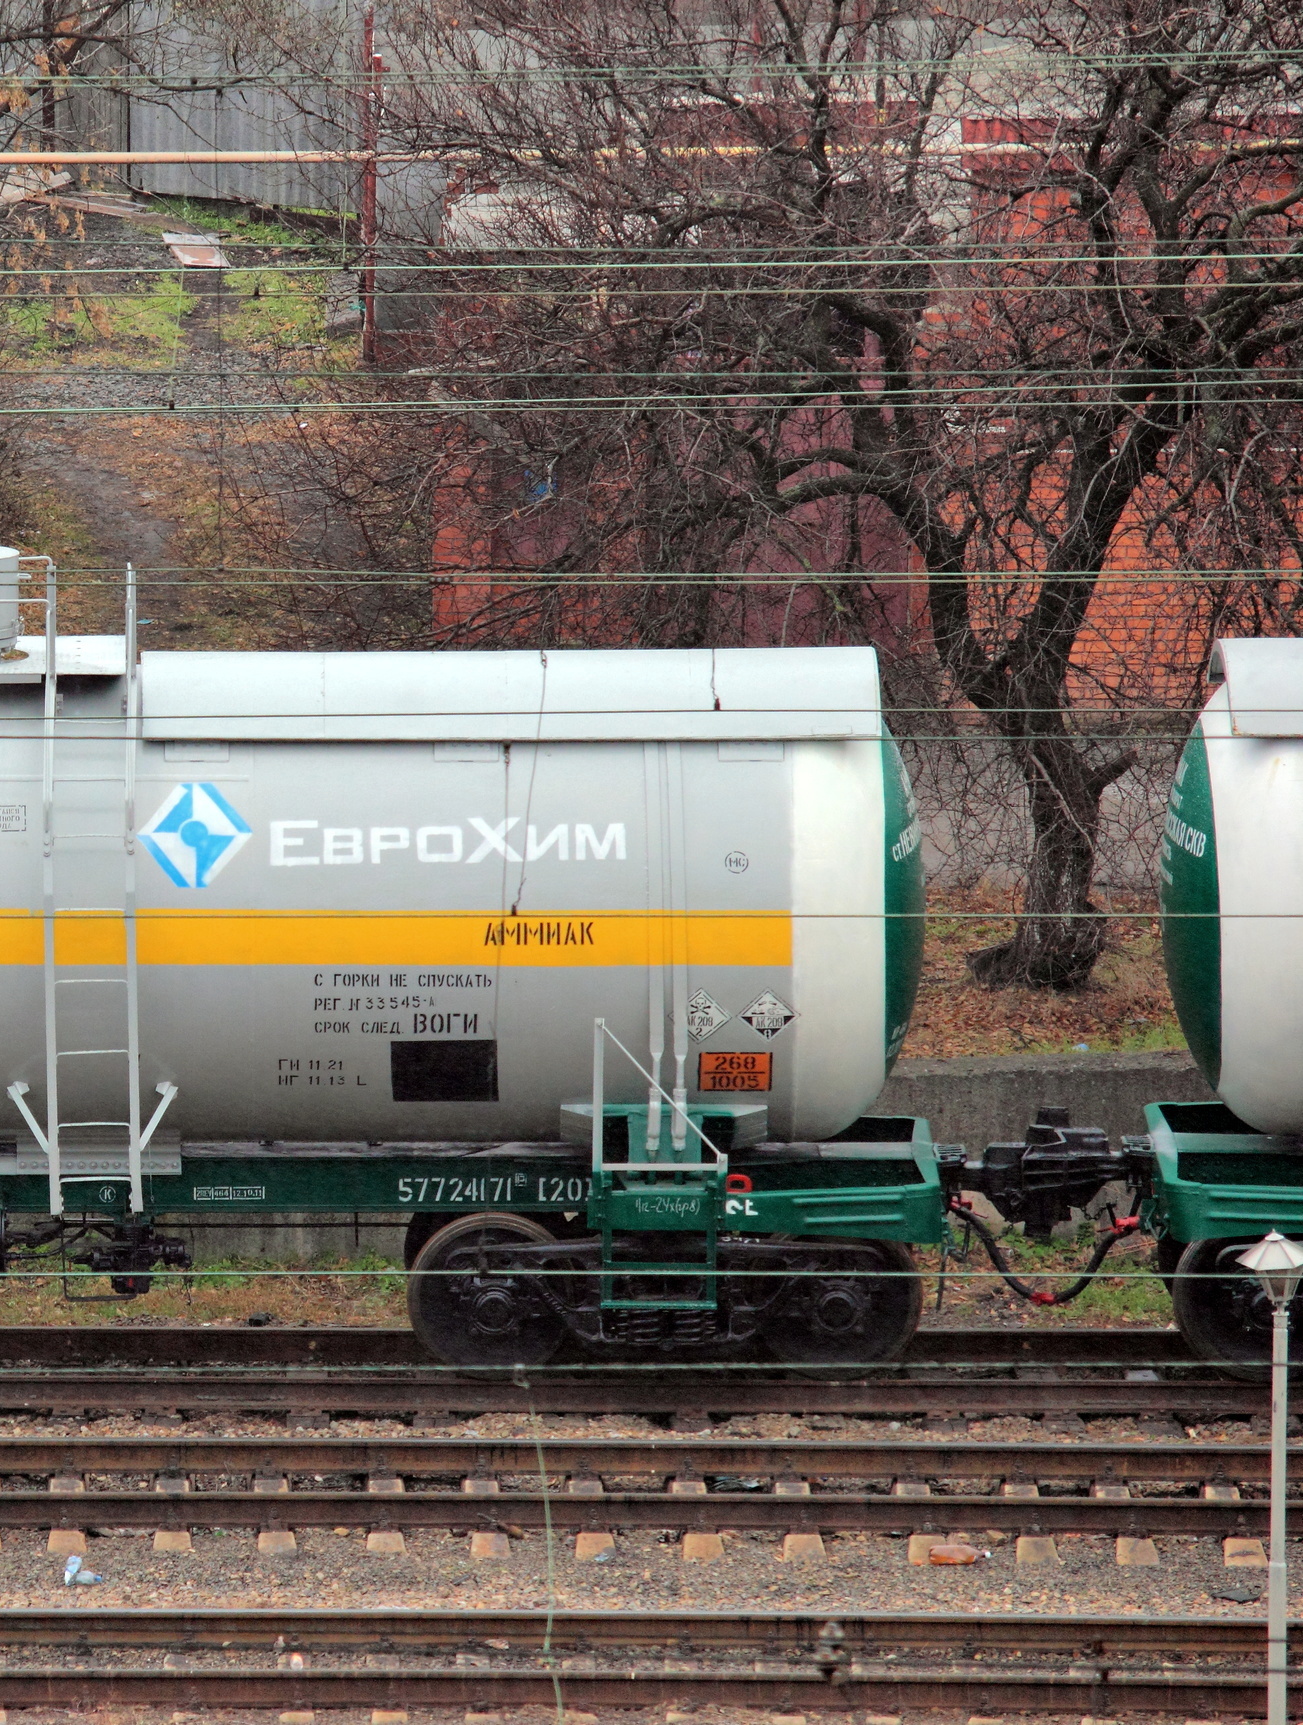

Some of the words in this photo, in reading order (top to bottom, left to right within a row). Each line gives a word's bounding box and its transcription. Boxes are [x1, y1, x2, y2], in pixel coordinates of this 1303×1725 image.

[484, 922, 595, 946] АММИАК
[314, 974, 323, 987] С
[333, 974, 380, 988] ГОРКИ
[390, 974, 407, 988] НЕ
[418, 974, 492, 988] СПУСКАТЬ
[314, 1021, 351, 1034] СРОК
[361, 1021, 405, 1035] СЛЕД.
[413, 1013, 478, 1034] ВОГИ
[696, 1028, 703, 1037] 2
[714, 1056, 756, 1070] 268
[710, 1075, 759, 1089] 1005
[104, 1189, 112, 1200] К
[398, 1177, 511, 1203] 57724171
